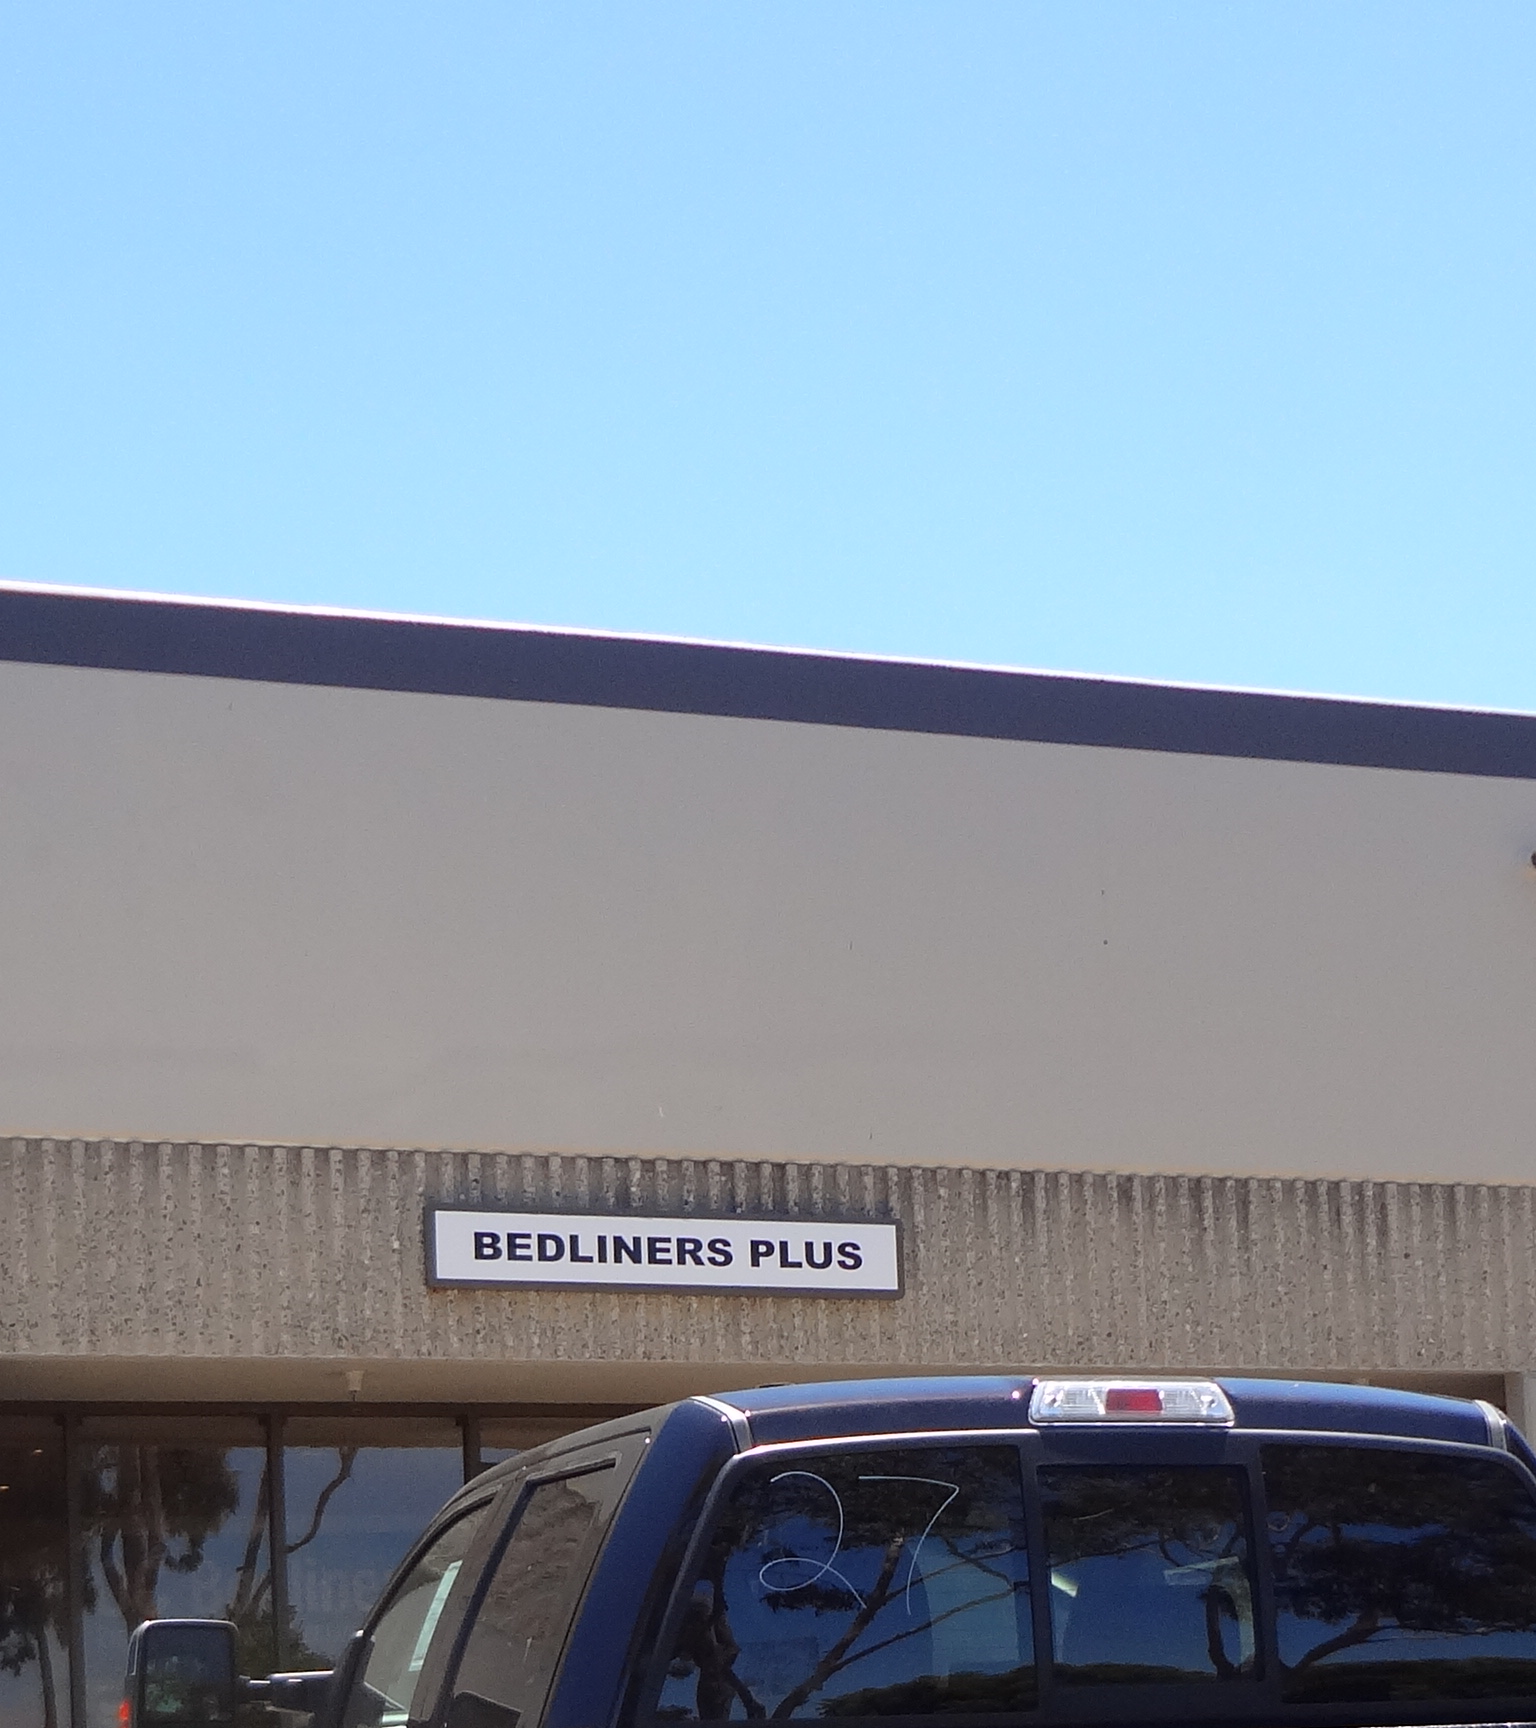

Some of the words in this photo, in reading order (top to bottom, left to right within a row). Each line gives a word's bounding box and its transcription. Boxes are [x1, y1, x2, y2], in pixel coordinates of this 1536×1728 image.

[472, 1231, 734, 1268] BEDLINERS
[749, 1238, 864, 1271] PLUS
[759, 1470, 960, 1615] 27
